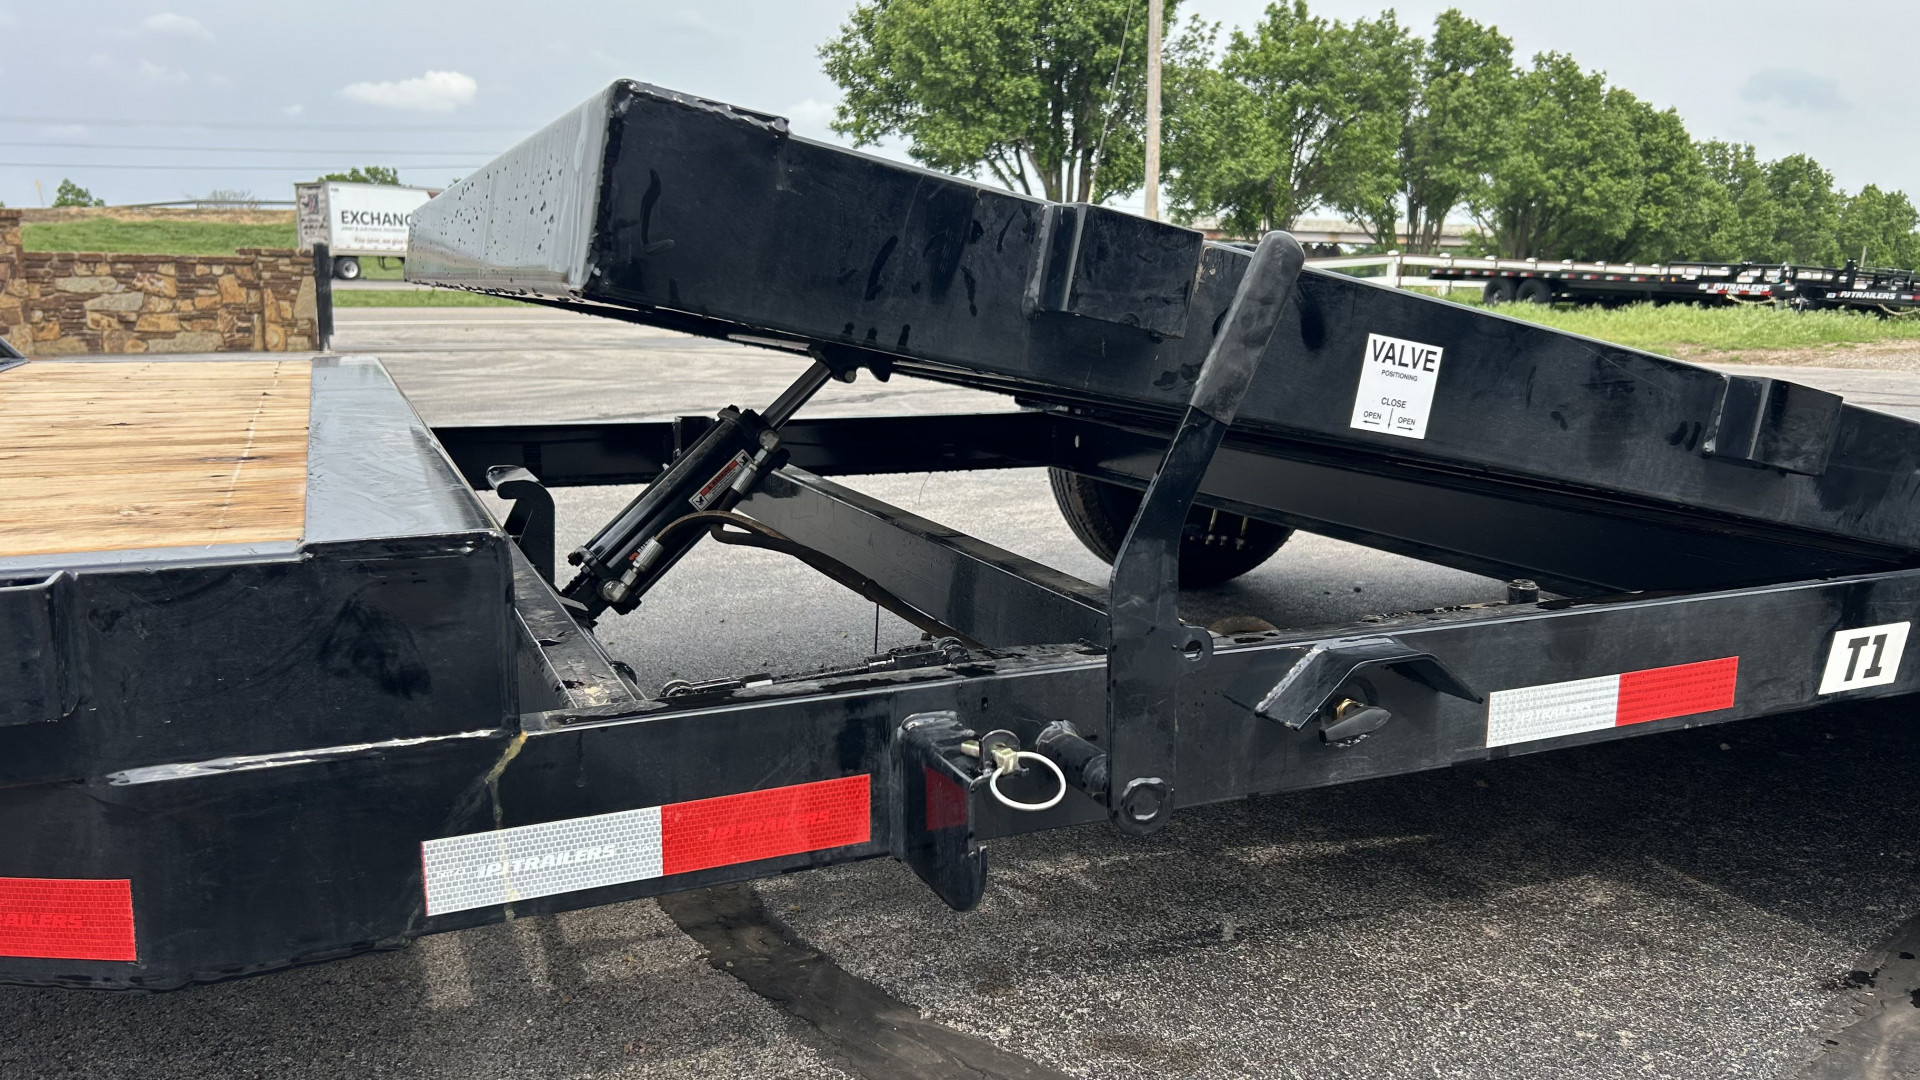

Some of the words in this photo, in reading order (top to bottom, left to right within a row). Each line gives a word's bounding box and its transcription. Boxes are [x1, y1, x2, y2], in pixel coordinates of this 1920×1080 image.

[1372, 339, 1438, 373] VALVE
[1380, 369, 1418, 382] POSITIONING
[1381, 396, 1407, 409] CLOSE
[1363, 410, 1382, 420] OPEN
[1397, 416, 1416, 426] OPEN
[1843, 633, 1888, 682] T1
